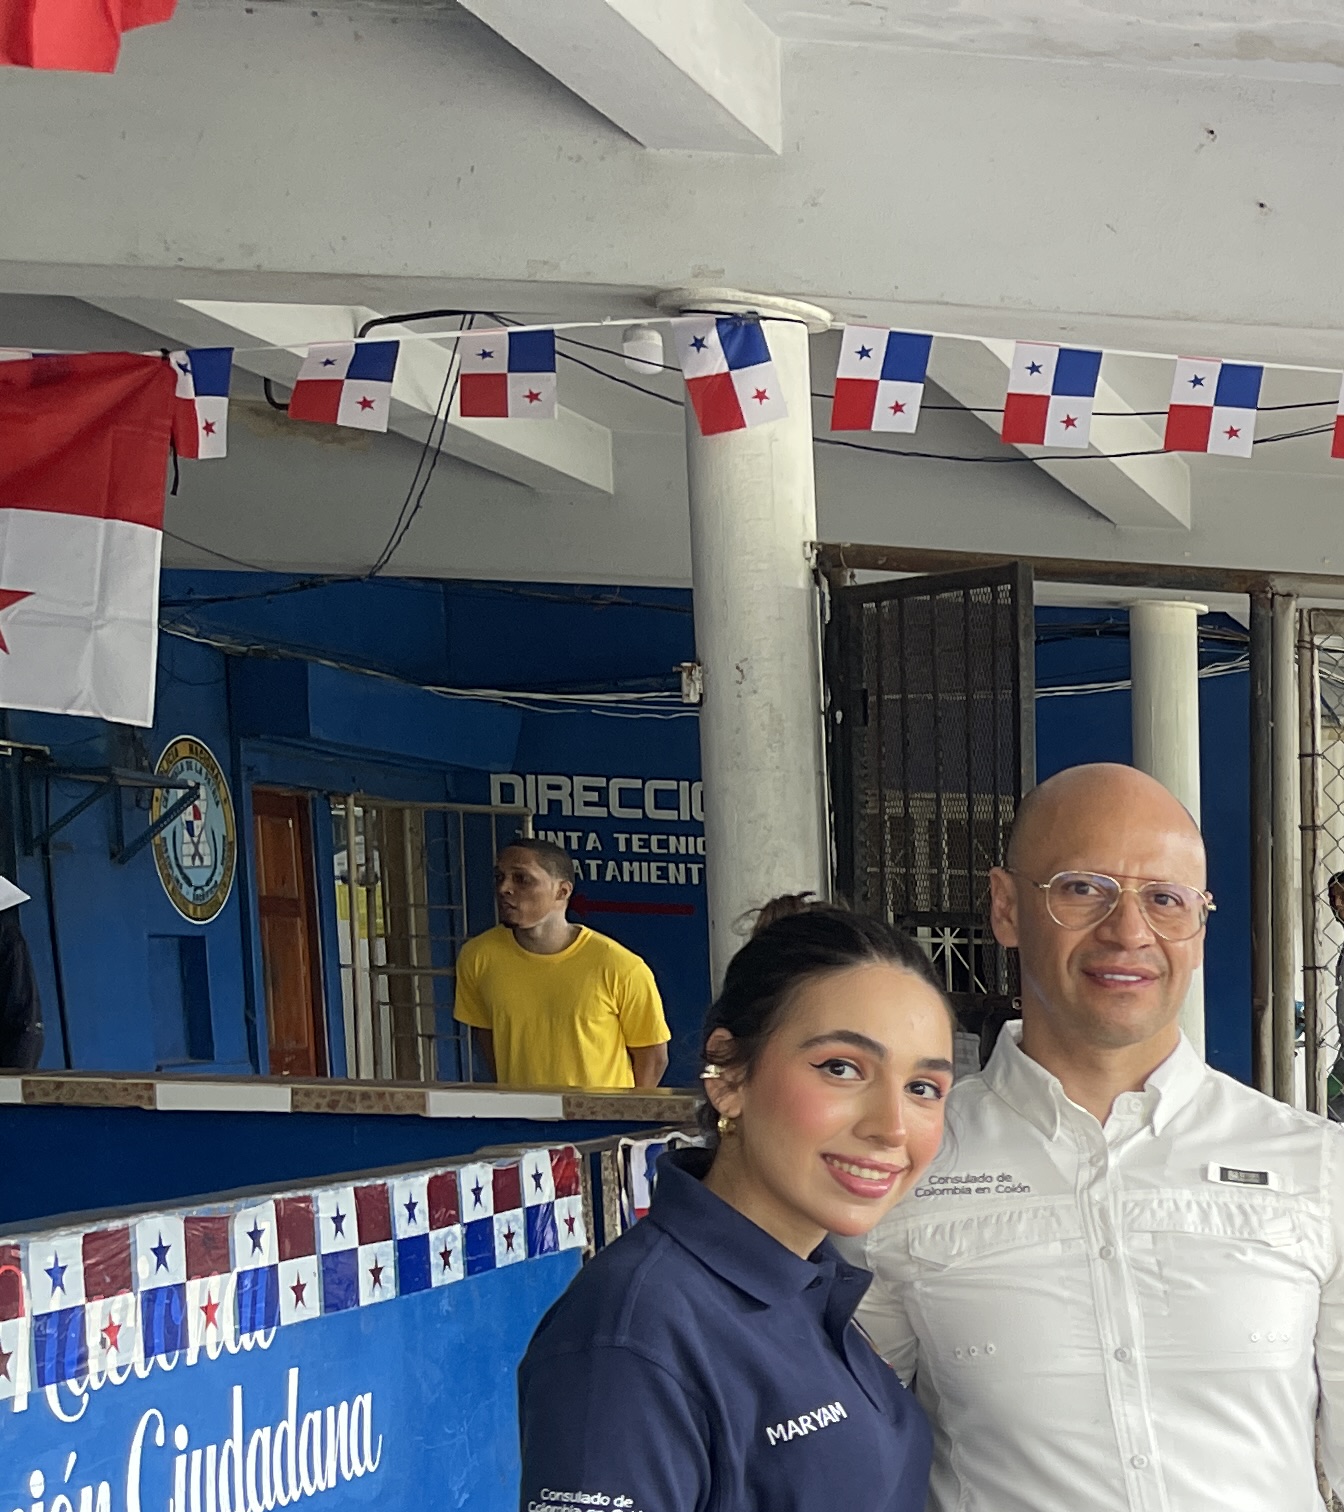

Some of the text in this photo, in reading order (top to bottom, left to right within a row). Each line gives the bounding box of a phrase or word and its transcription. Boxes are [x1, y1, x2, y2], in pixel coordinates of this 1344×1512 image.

[928, 1172, 1013, 1185] Consulado de
[914, 1182, 1031, 1198] Colombia en Colón
[765, 1401, 848, 1446] MARYAM
[540, 1488, 634, 1508] Consulado de
